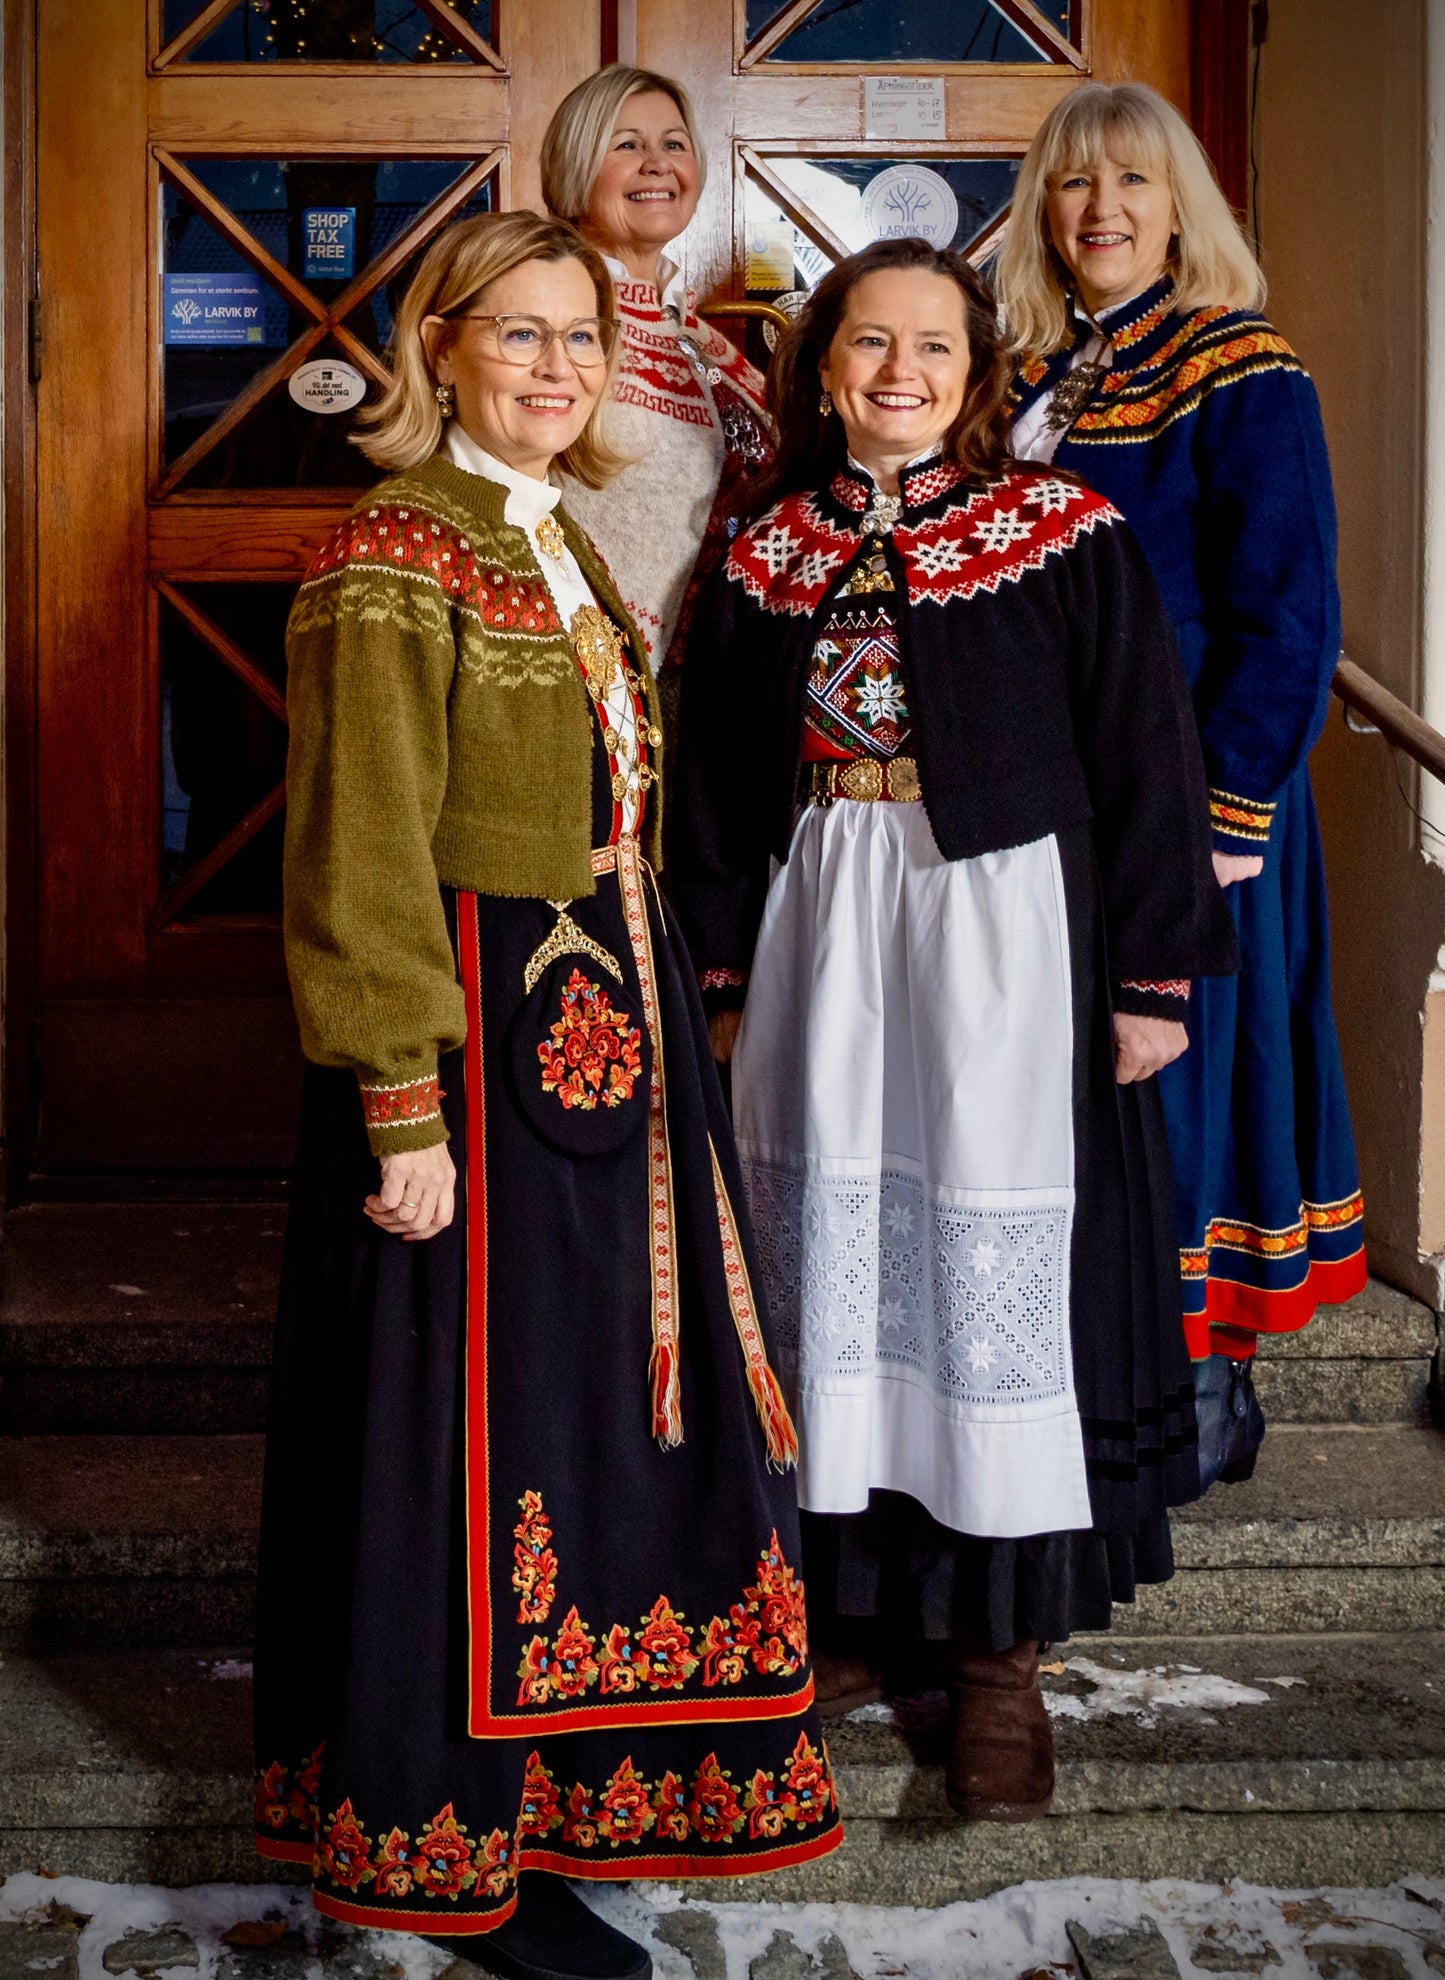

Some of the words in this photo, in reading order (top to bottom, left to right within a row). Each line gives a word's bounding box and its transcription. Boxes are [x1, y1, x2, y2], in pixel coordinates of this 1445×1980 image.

[308, 214, 349, 228] SHOP
[307, 229, 338, 243] TAX
[879, 225, 920, 237] LARVIK
[923, 225, 938, 236] BY
[308, 244, 345, 259] FREE
[204, 307, 242, 318] LARVIK
[243, 307, 258, 318] BY
